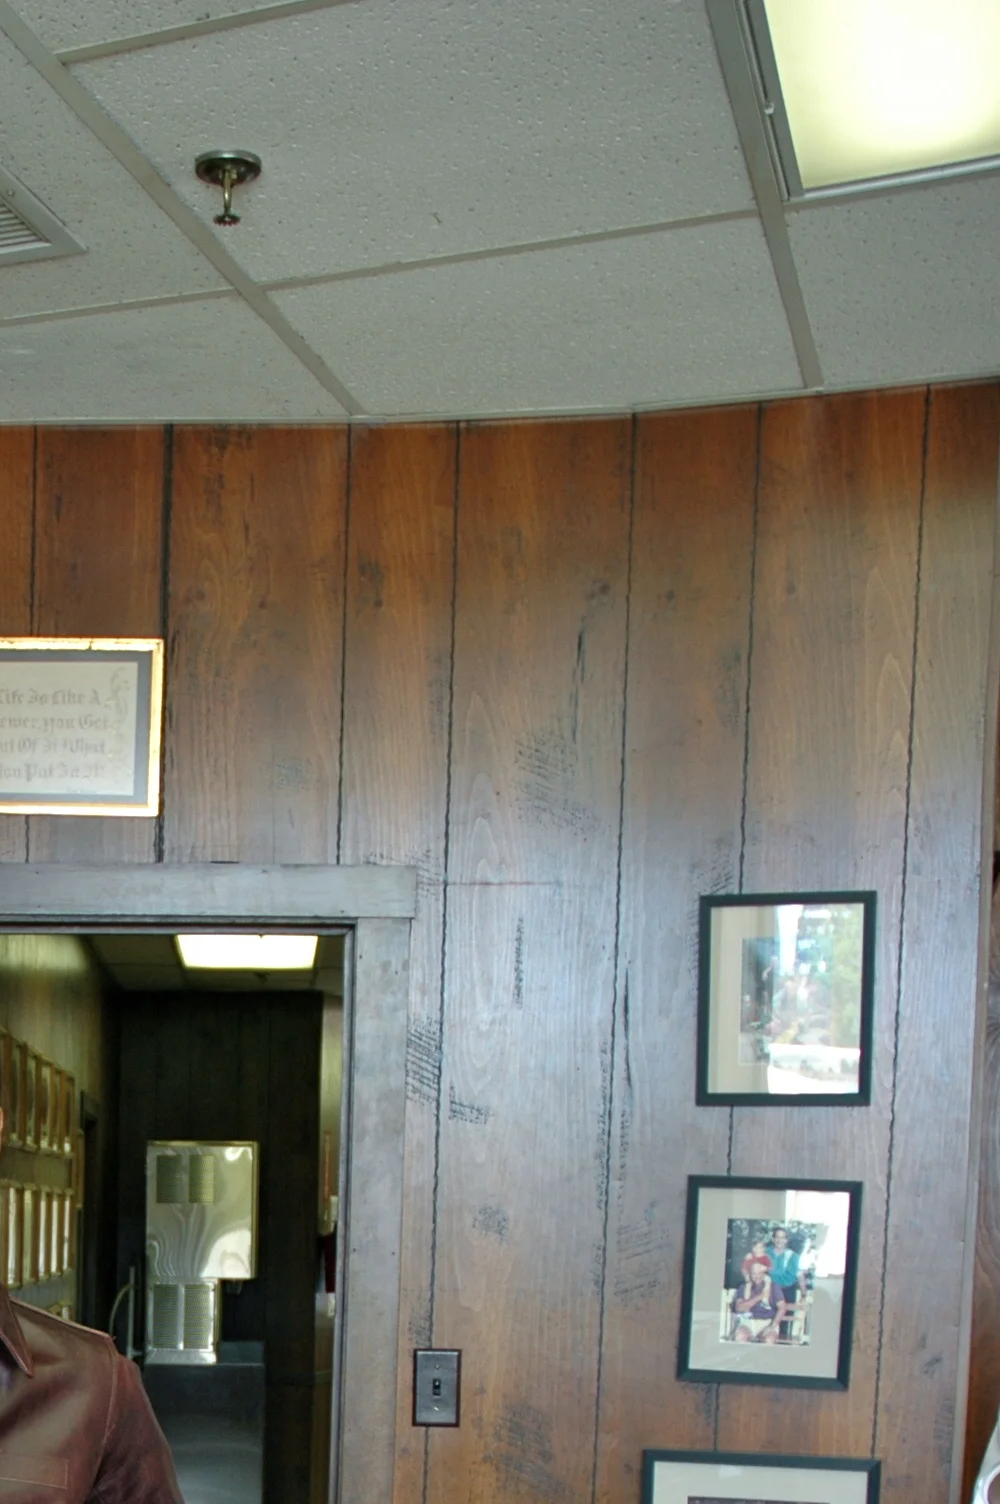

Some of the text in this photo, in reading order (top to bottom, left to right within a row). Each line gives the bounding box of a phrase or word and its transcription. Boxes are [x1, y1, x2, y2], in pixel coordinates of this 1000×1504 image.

[28, 688, 48, 705] Is
[52, 688, 86, 705] Like
[89, 688, 101, 705] A
[78, 713, 109, 731] Get
[18, 736, 38, 755] Of
[62, 736, 106, 756] What
[24, 762, 54, 782] Put
